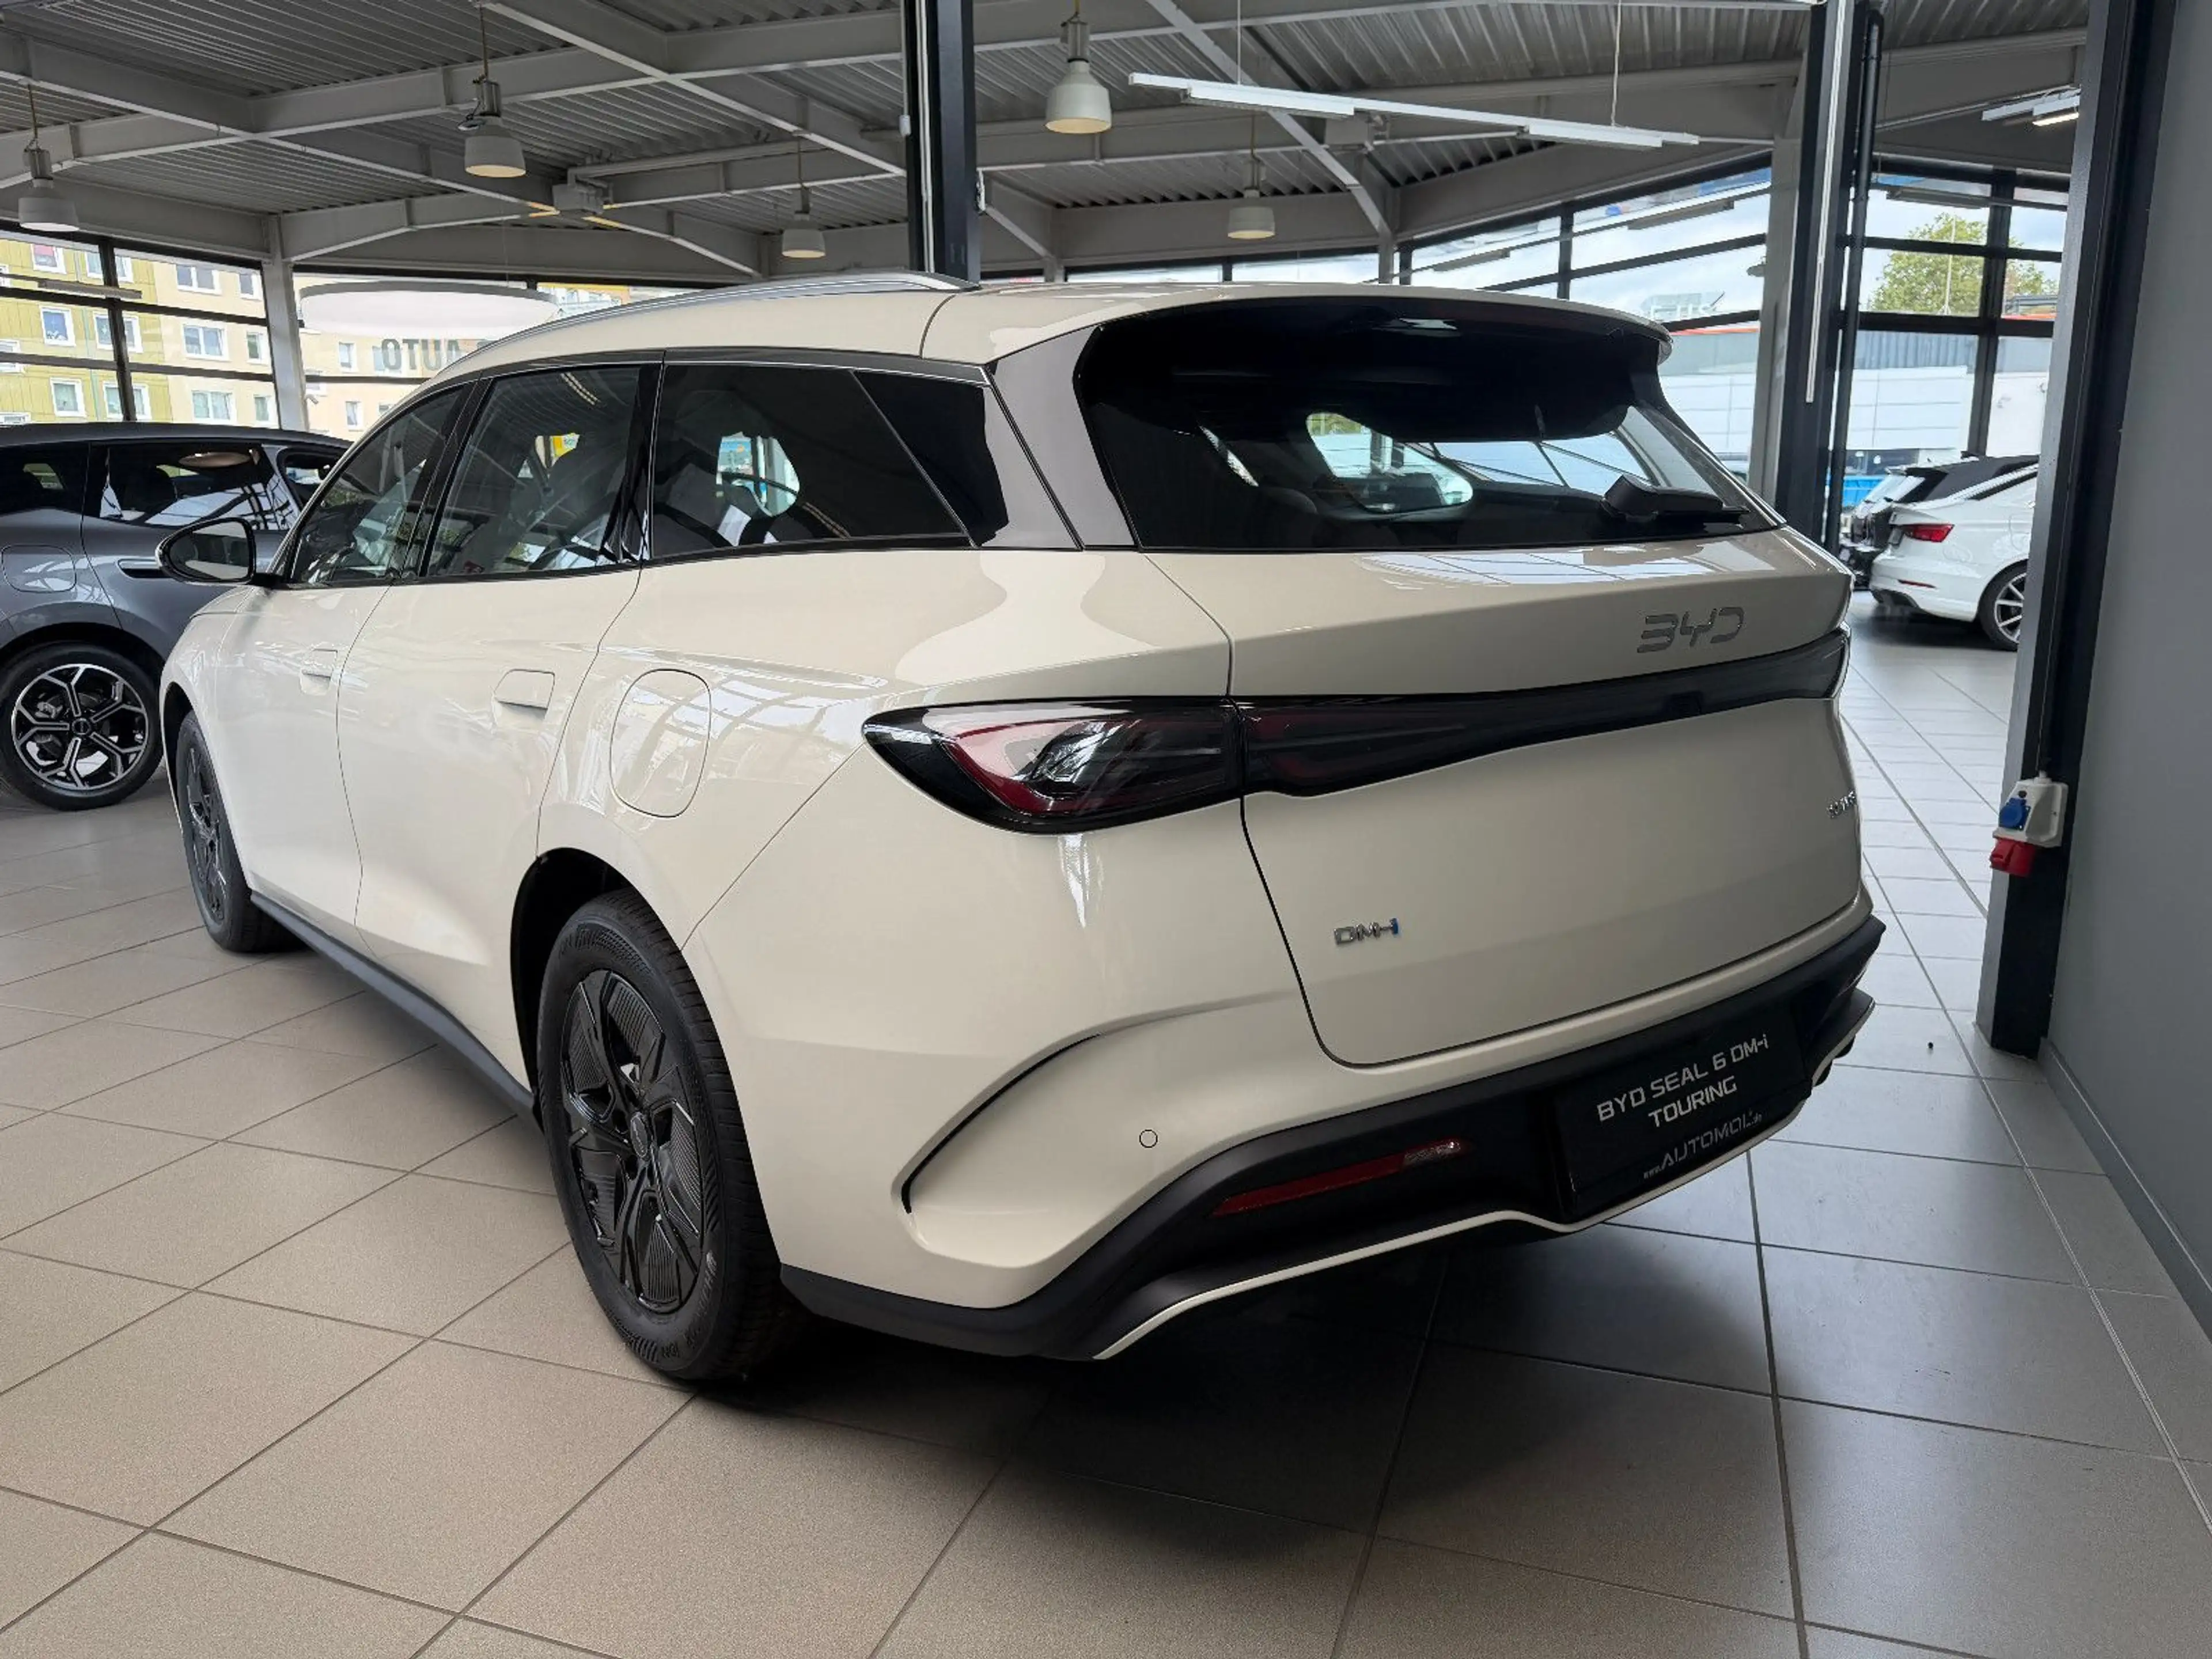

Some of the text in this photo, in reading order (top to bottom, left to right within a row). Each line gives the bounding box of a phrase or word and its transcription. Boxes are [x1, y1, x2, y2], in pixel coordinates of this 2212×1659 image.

[1637, 607, 1744, 653] BYD
[1597, 1034, 1768, 1122] BYD SEAL 6 DM-i
[1648, 1075, 1737, 1127] TOURING
